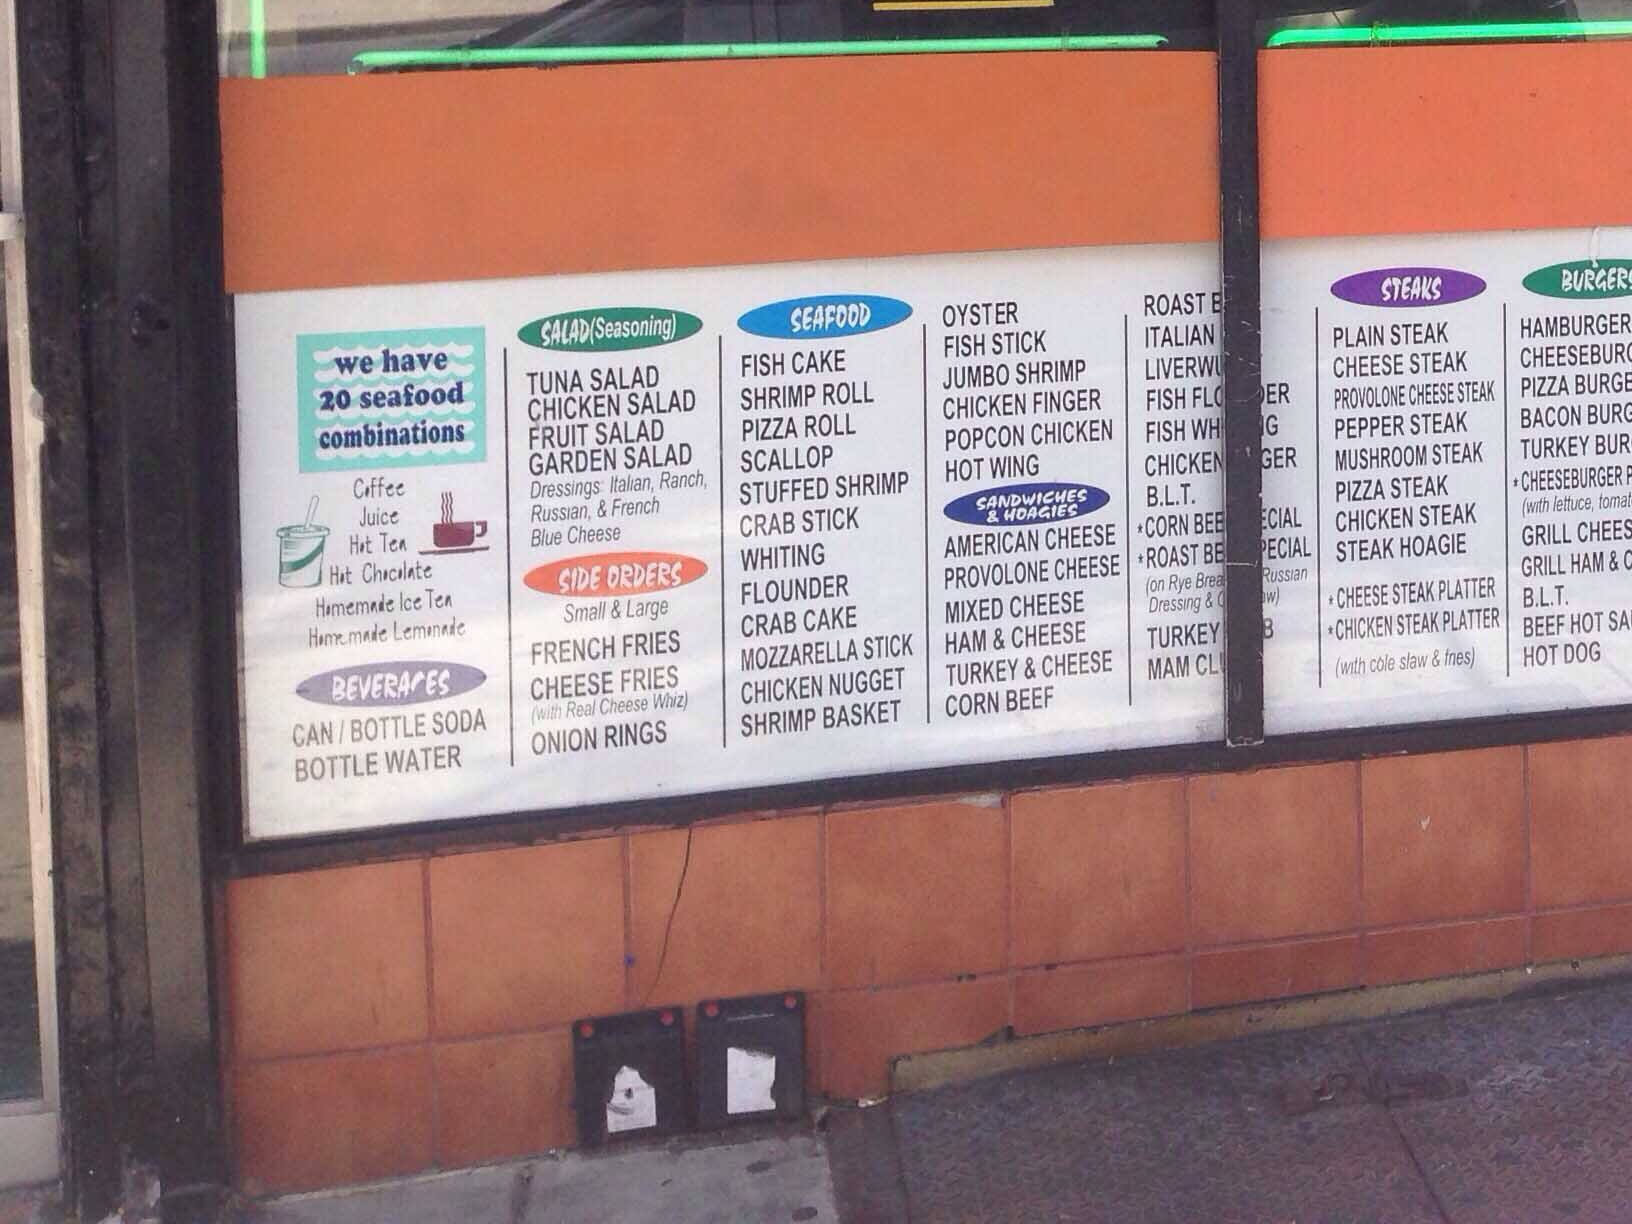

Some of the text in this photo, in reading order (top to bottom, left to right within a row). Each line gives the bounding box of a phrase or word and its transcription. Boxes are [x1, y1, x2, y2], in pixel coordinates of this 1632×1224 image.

[1382, 276, 1441, 301] STEAKS
[791, 303, 871, 332] SEAFOOD
[943, 302, 1018, 327] OYSTER
[1521, 313, 1631, 338] HAMBURGER
[945, 330, 1046, 357] FISH STICK
[1146, 323, 1214, 348] ITALIAN
[1334, 322, 1448, 348] PLAIN STEAK
[334, 349, 447, 374] we have
[742, 350, 845, 377] FISH CAKE
[1334, 351, 1467, 378] CHEESE STEAK
[526, 365, 659, 395] TUNA SALAD
[320, 381, 464, 411] 20 seafood
[528, 390, 695, 422] CHICKEN SALAD
[741, 381, 874, 411] SHRIMP ROLL
[319, 419, 464, 449] combinations
[529, 419, 664, 450] FRUIT SALAD
[1521, 435, 1589, 459] TURKEY
[529, 443, 691, 476] GARDEN SALAD
[741, 445, 833, 473] SCALLOP
[1336, 442, 1482, 471] MUSHROOM STEAK
[354, 477, 404, 499] Coffee
[740, 472, 908, 505] STUFFED SHRIMP
[976, 489, 1087, 510] SANDWICHES
[1147, 483, 1195, 507] B.L.T.
[360, 506, 398, 527] Juice
[987, 503, 1079, 523] & HOAGIES
[1522, 497, 1549, 518] (with
[1553, 496, 1593, 512] lettuce,
[531, 526, 621, 547] Blue Cheese
[944, 524, 1115, 558] AMERICAN CHEESE
[1336, 533, 1466, 562] STEAK HOAGIE
[741, 543, 824, 571] WHITING
[945, 554, 1120, 589] PROVOLONE CHEESE
[330, 560, 432, 585] Hot Chocolate
[559, 561, 682, 594] SIDE ORDERS
[742, 575, 848, 605] FLOUNDER
[564, 600, 668, 623] Small & Large
[532, 630, 680, 665] FRENCH FRIES
[742, 634, 912, 671] MOZZARELLA STICK
[1524, 641, 1600, 667] HOT DOG
[1336, 647, 1475, 678] (with cole slaw & fries)
[531, 665, 678, 700] CHEESE FRIES
[531, 691, 688, 726] (with Real Cheese Whiz)
[946, 686, 1053, 717] CORN BEEF
[742, 700, 901, 737] SHRIMP BASKET
[532, 720, 666, 755] ONION RINGS
[295, 745, 461, 782] BOTTLE WATER
